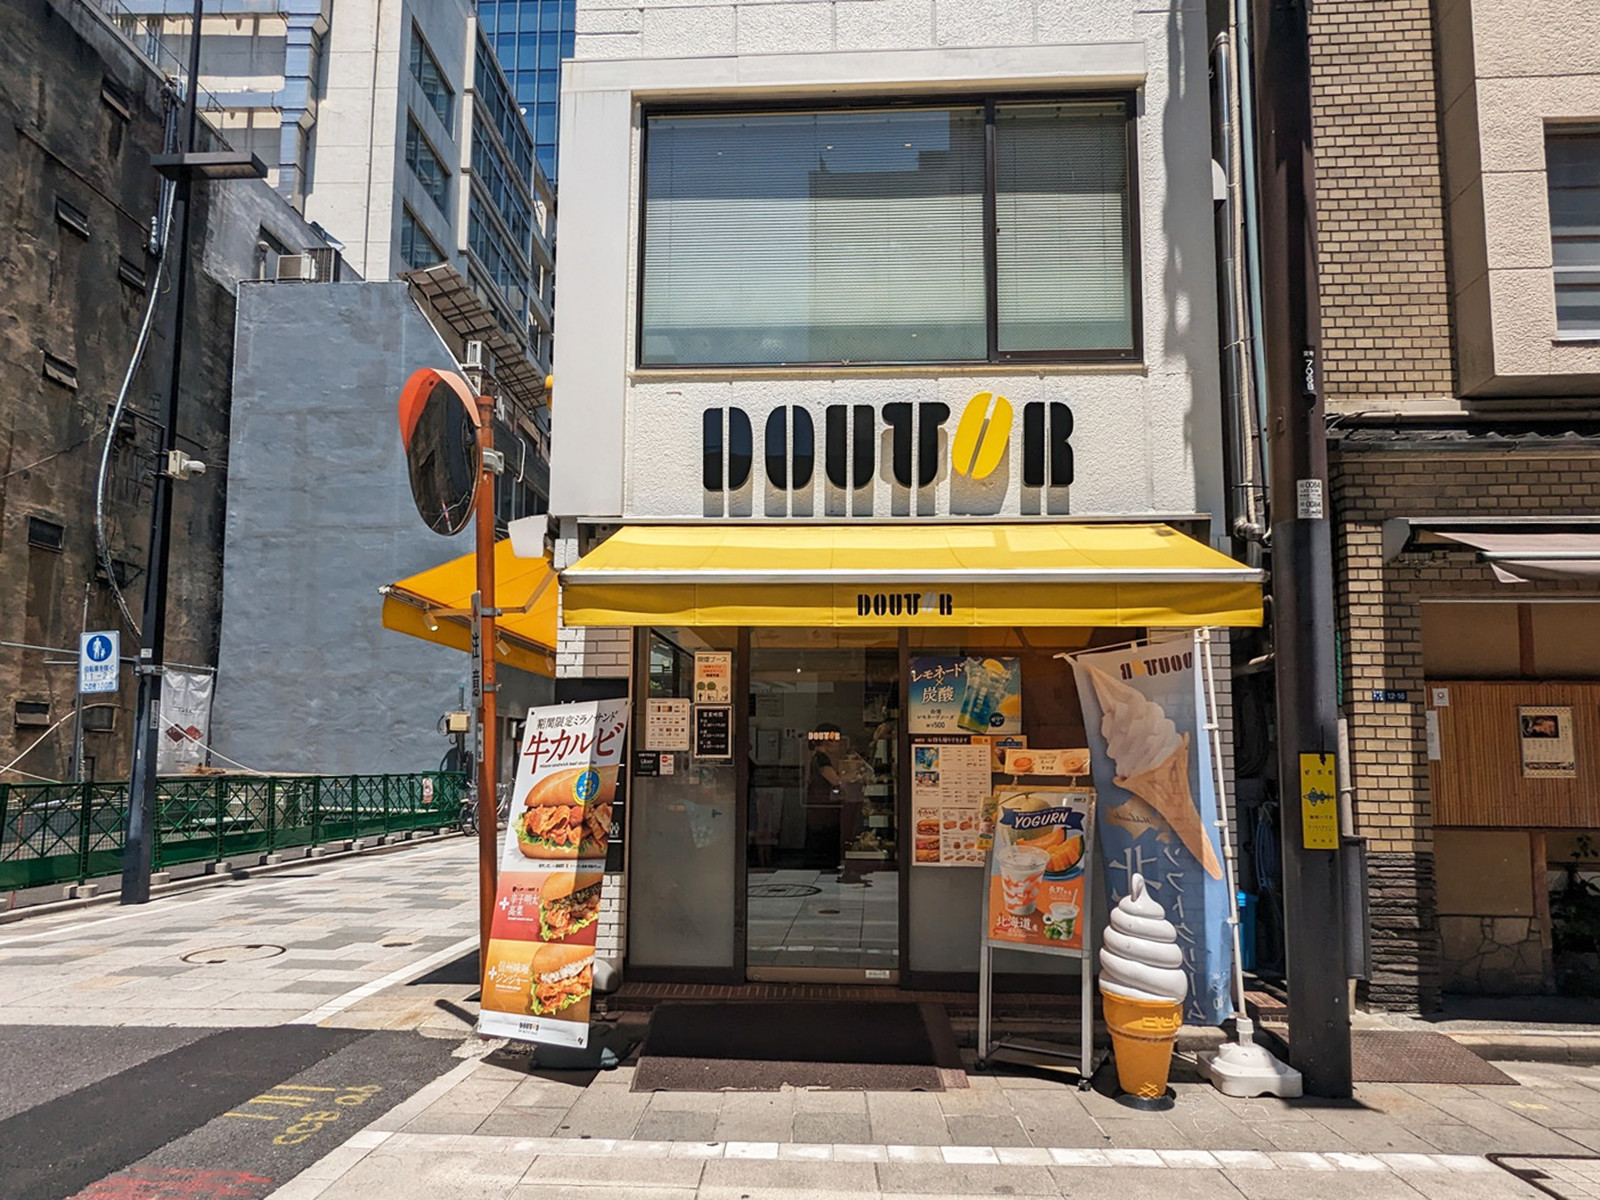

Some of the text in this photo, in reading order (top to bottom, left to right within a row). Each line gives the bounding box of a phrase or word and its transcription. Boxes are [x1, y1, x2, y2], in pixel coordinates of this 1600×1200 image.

[703, 392, 1074, 491] DOUTOR
[857, 591, 953, 616] DOUTOR
[922, 686, 954, 703] 炭酸
[523, 722, 625, 774] 牛カルビ
[1014, 812, 1068, 829] YOGURN
